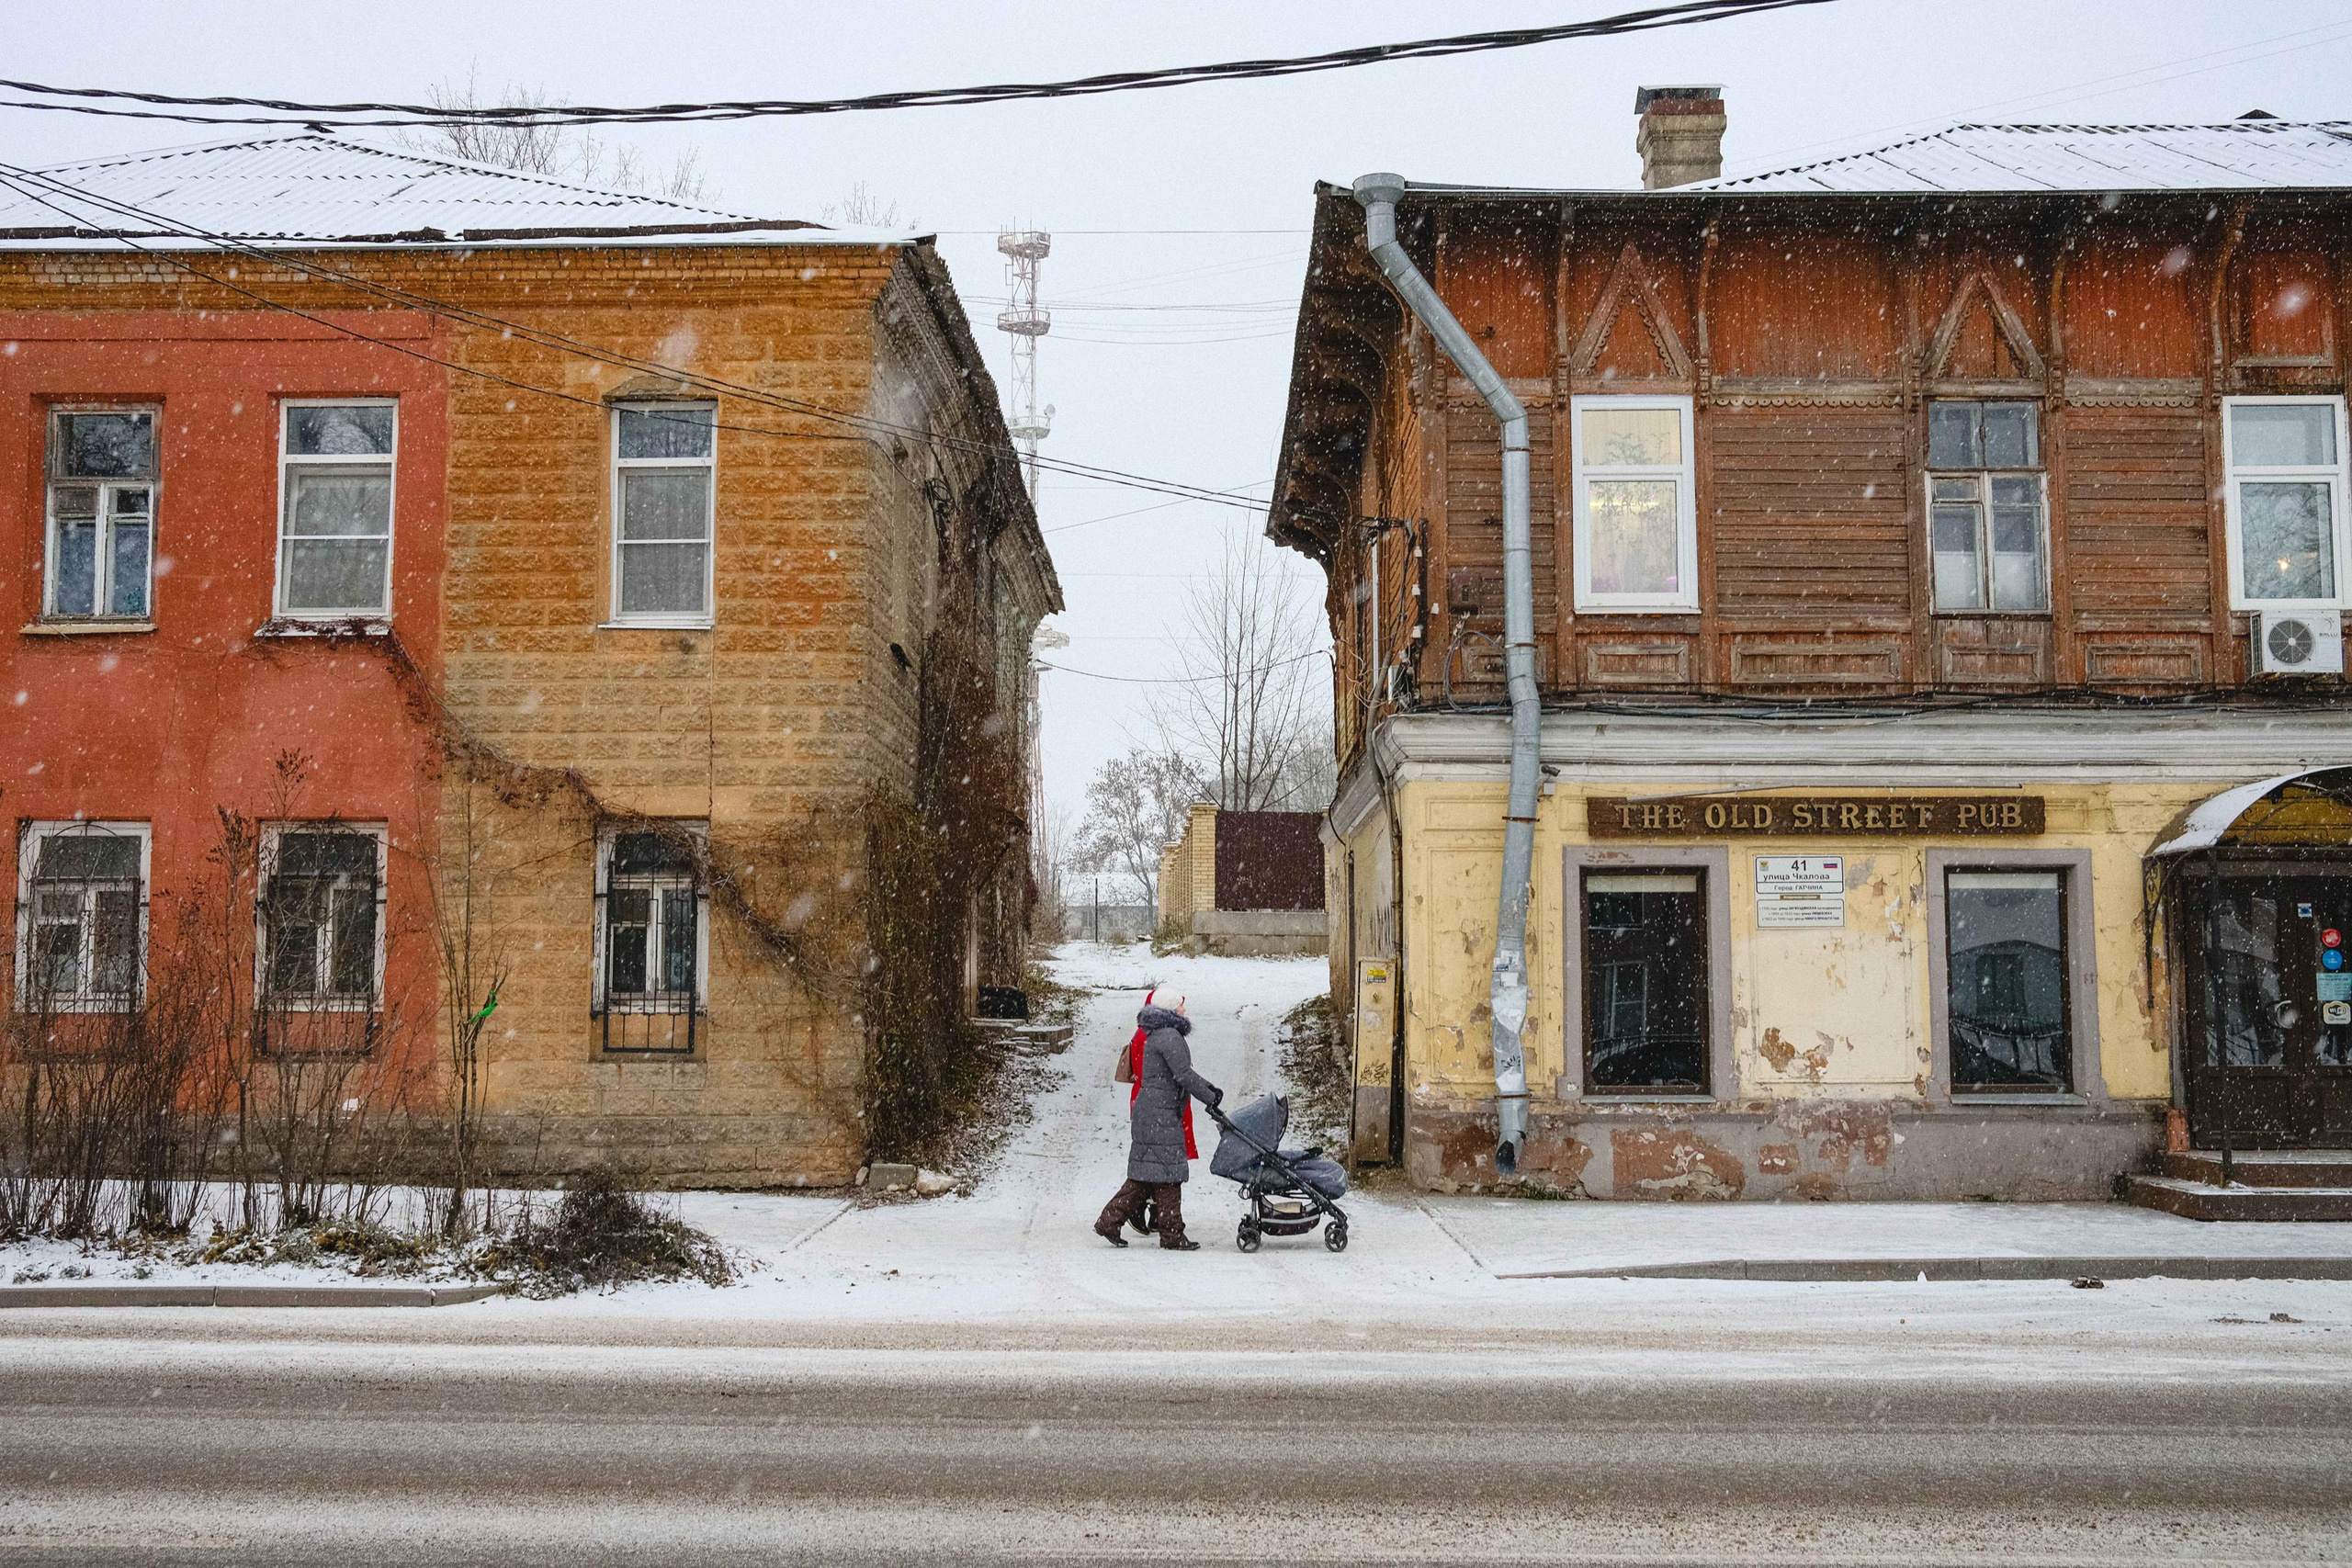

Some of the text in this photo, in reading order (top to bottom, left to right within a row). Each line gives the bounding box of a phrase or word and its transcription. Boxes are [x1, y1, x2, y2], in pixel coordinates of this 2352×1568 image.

[1614, 802, 2022, 829] THE OLD STREET PUB
[1792, 860, 1806, 871] 41
